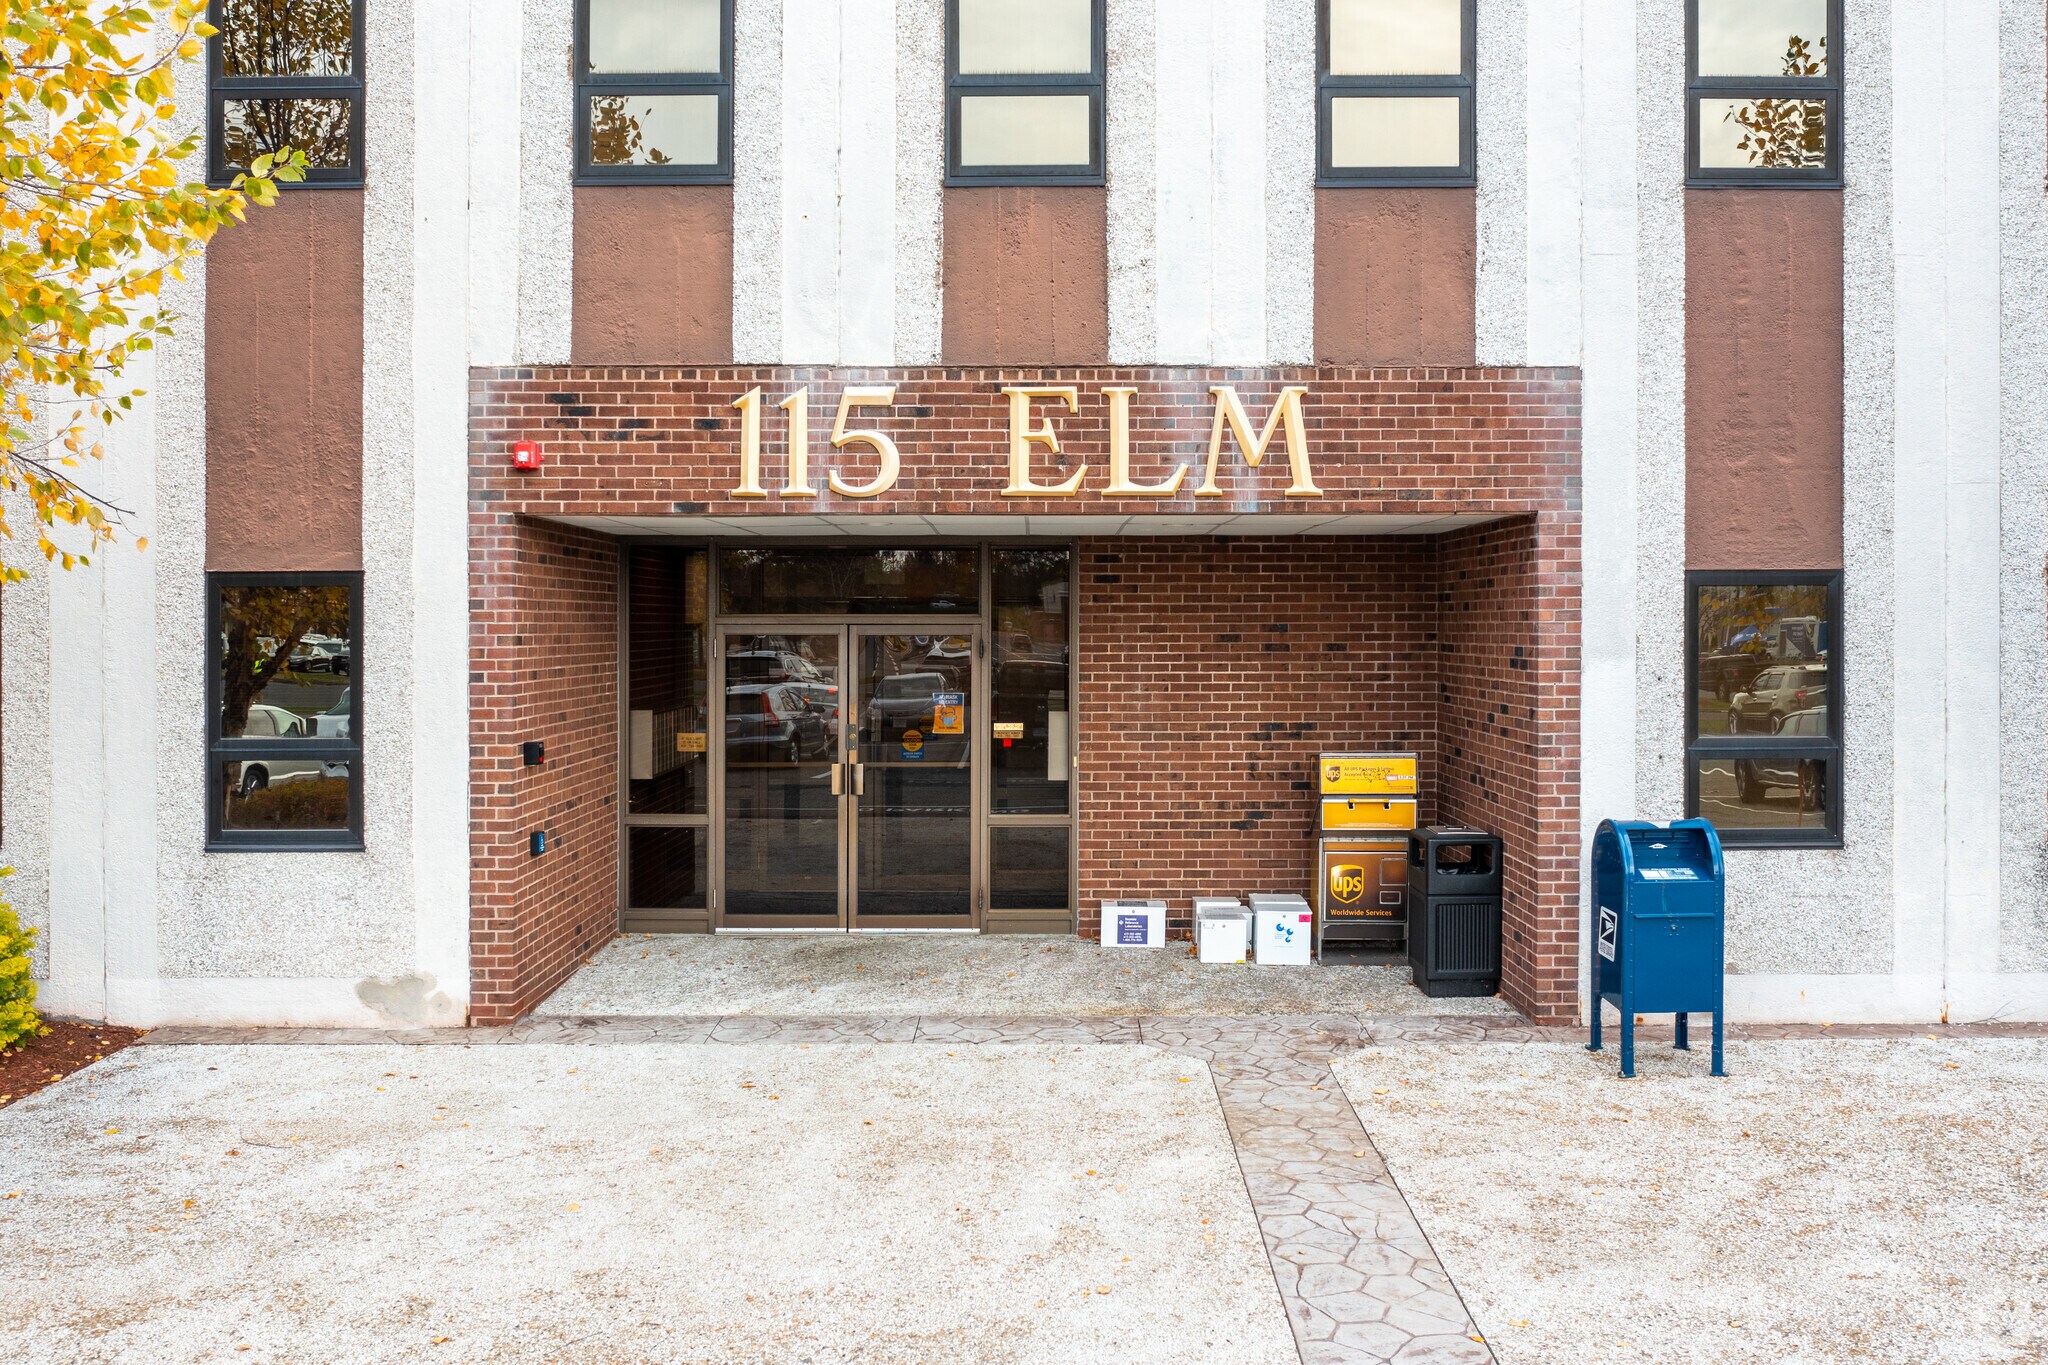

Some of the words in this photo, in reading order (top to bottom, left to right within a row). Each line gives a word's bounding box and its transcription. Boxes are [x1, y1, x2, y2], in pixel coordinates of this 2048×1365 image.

[731, 386, 900, 498] 115
[1000, 386, 1323, 497] ELM
[1326, 769, 1341, 780] ups
[1333, 876, 1362, 898] ups
